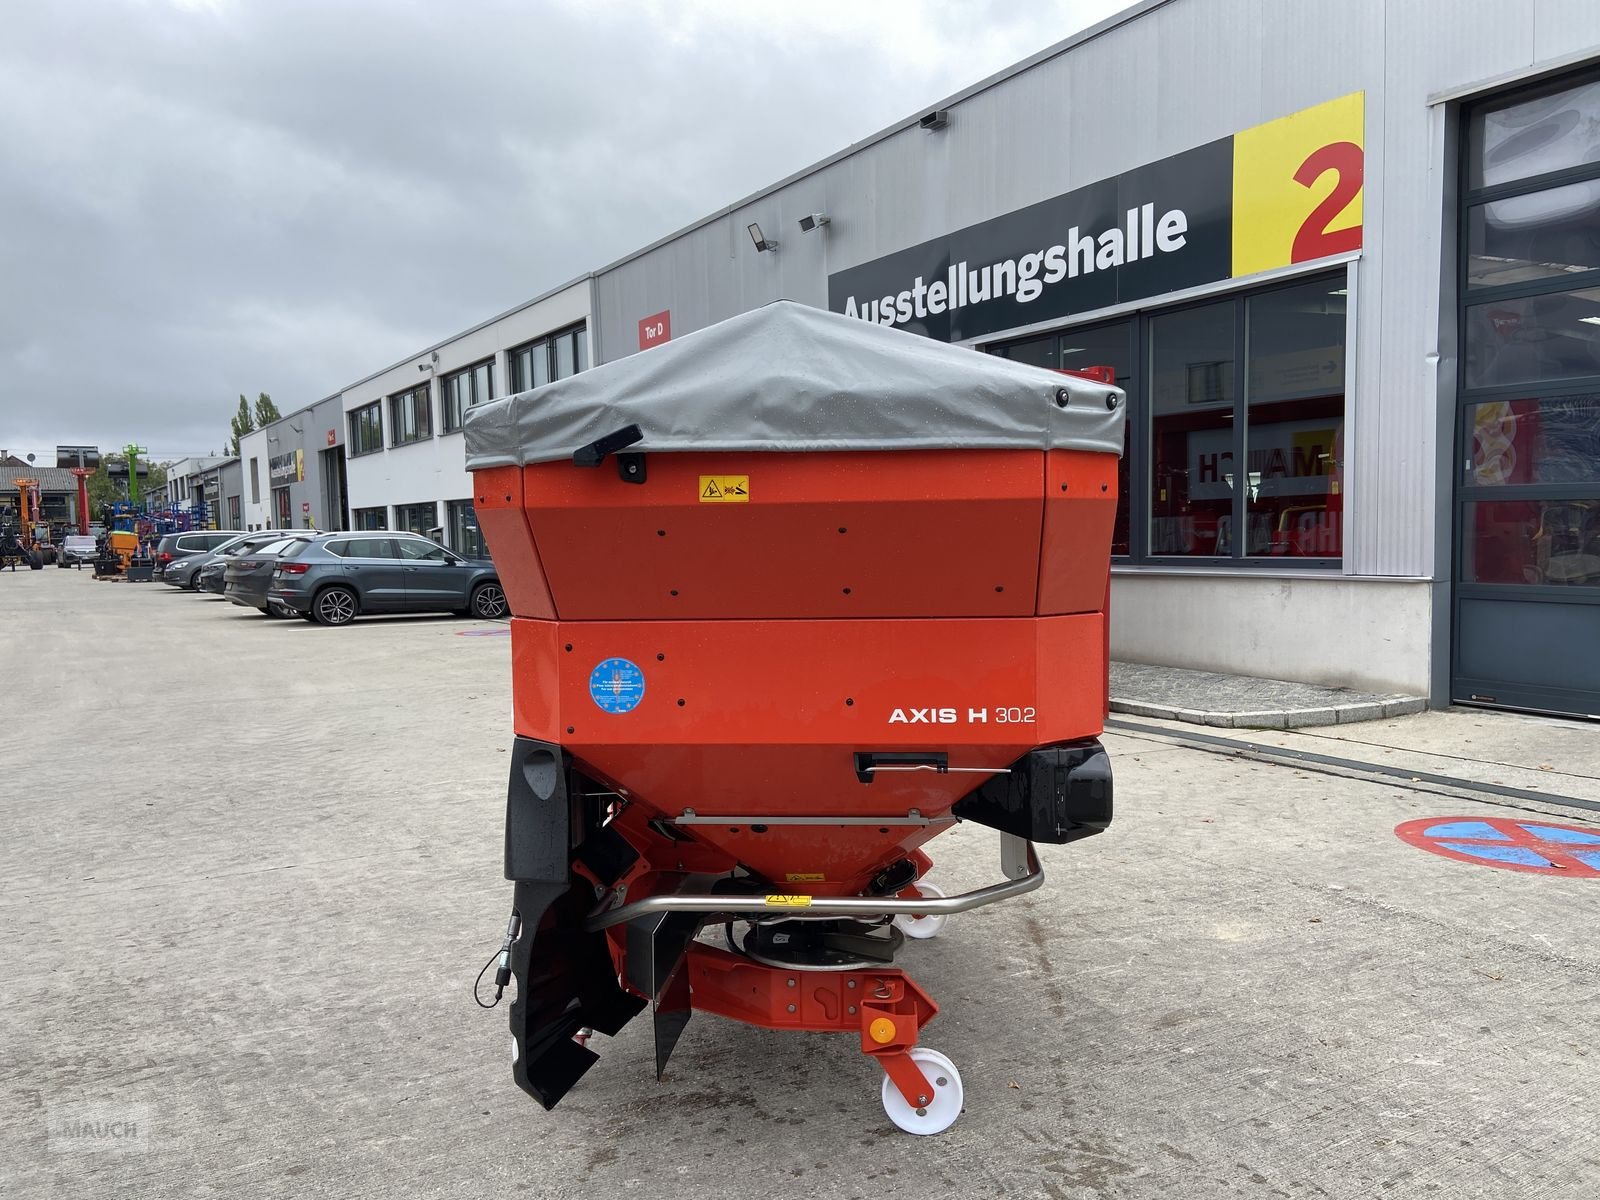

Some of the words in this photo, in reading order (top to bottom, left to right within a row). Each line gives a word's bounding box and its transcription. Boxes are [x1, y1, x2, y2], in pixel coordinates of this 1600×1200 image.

[844, 202, 1188, 327] Ausstellungshalle
[1291, 141, 1364, 264] 2
[645, 326, 656, 340] Tor
[657, 322, 663, 336] D
[888, 708, 957, 723] AXIS
[969, 708, 987, 723] H
[995, 707, 1036, 723] 30.2
